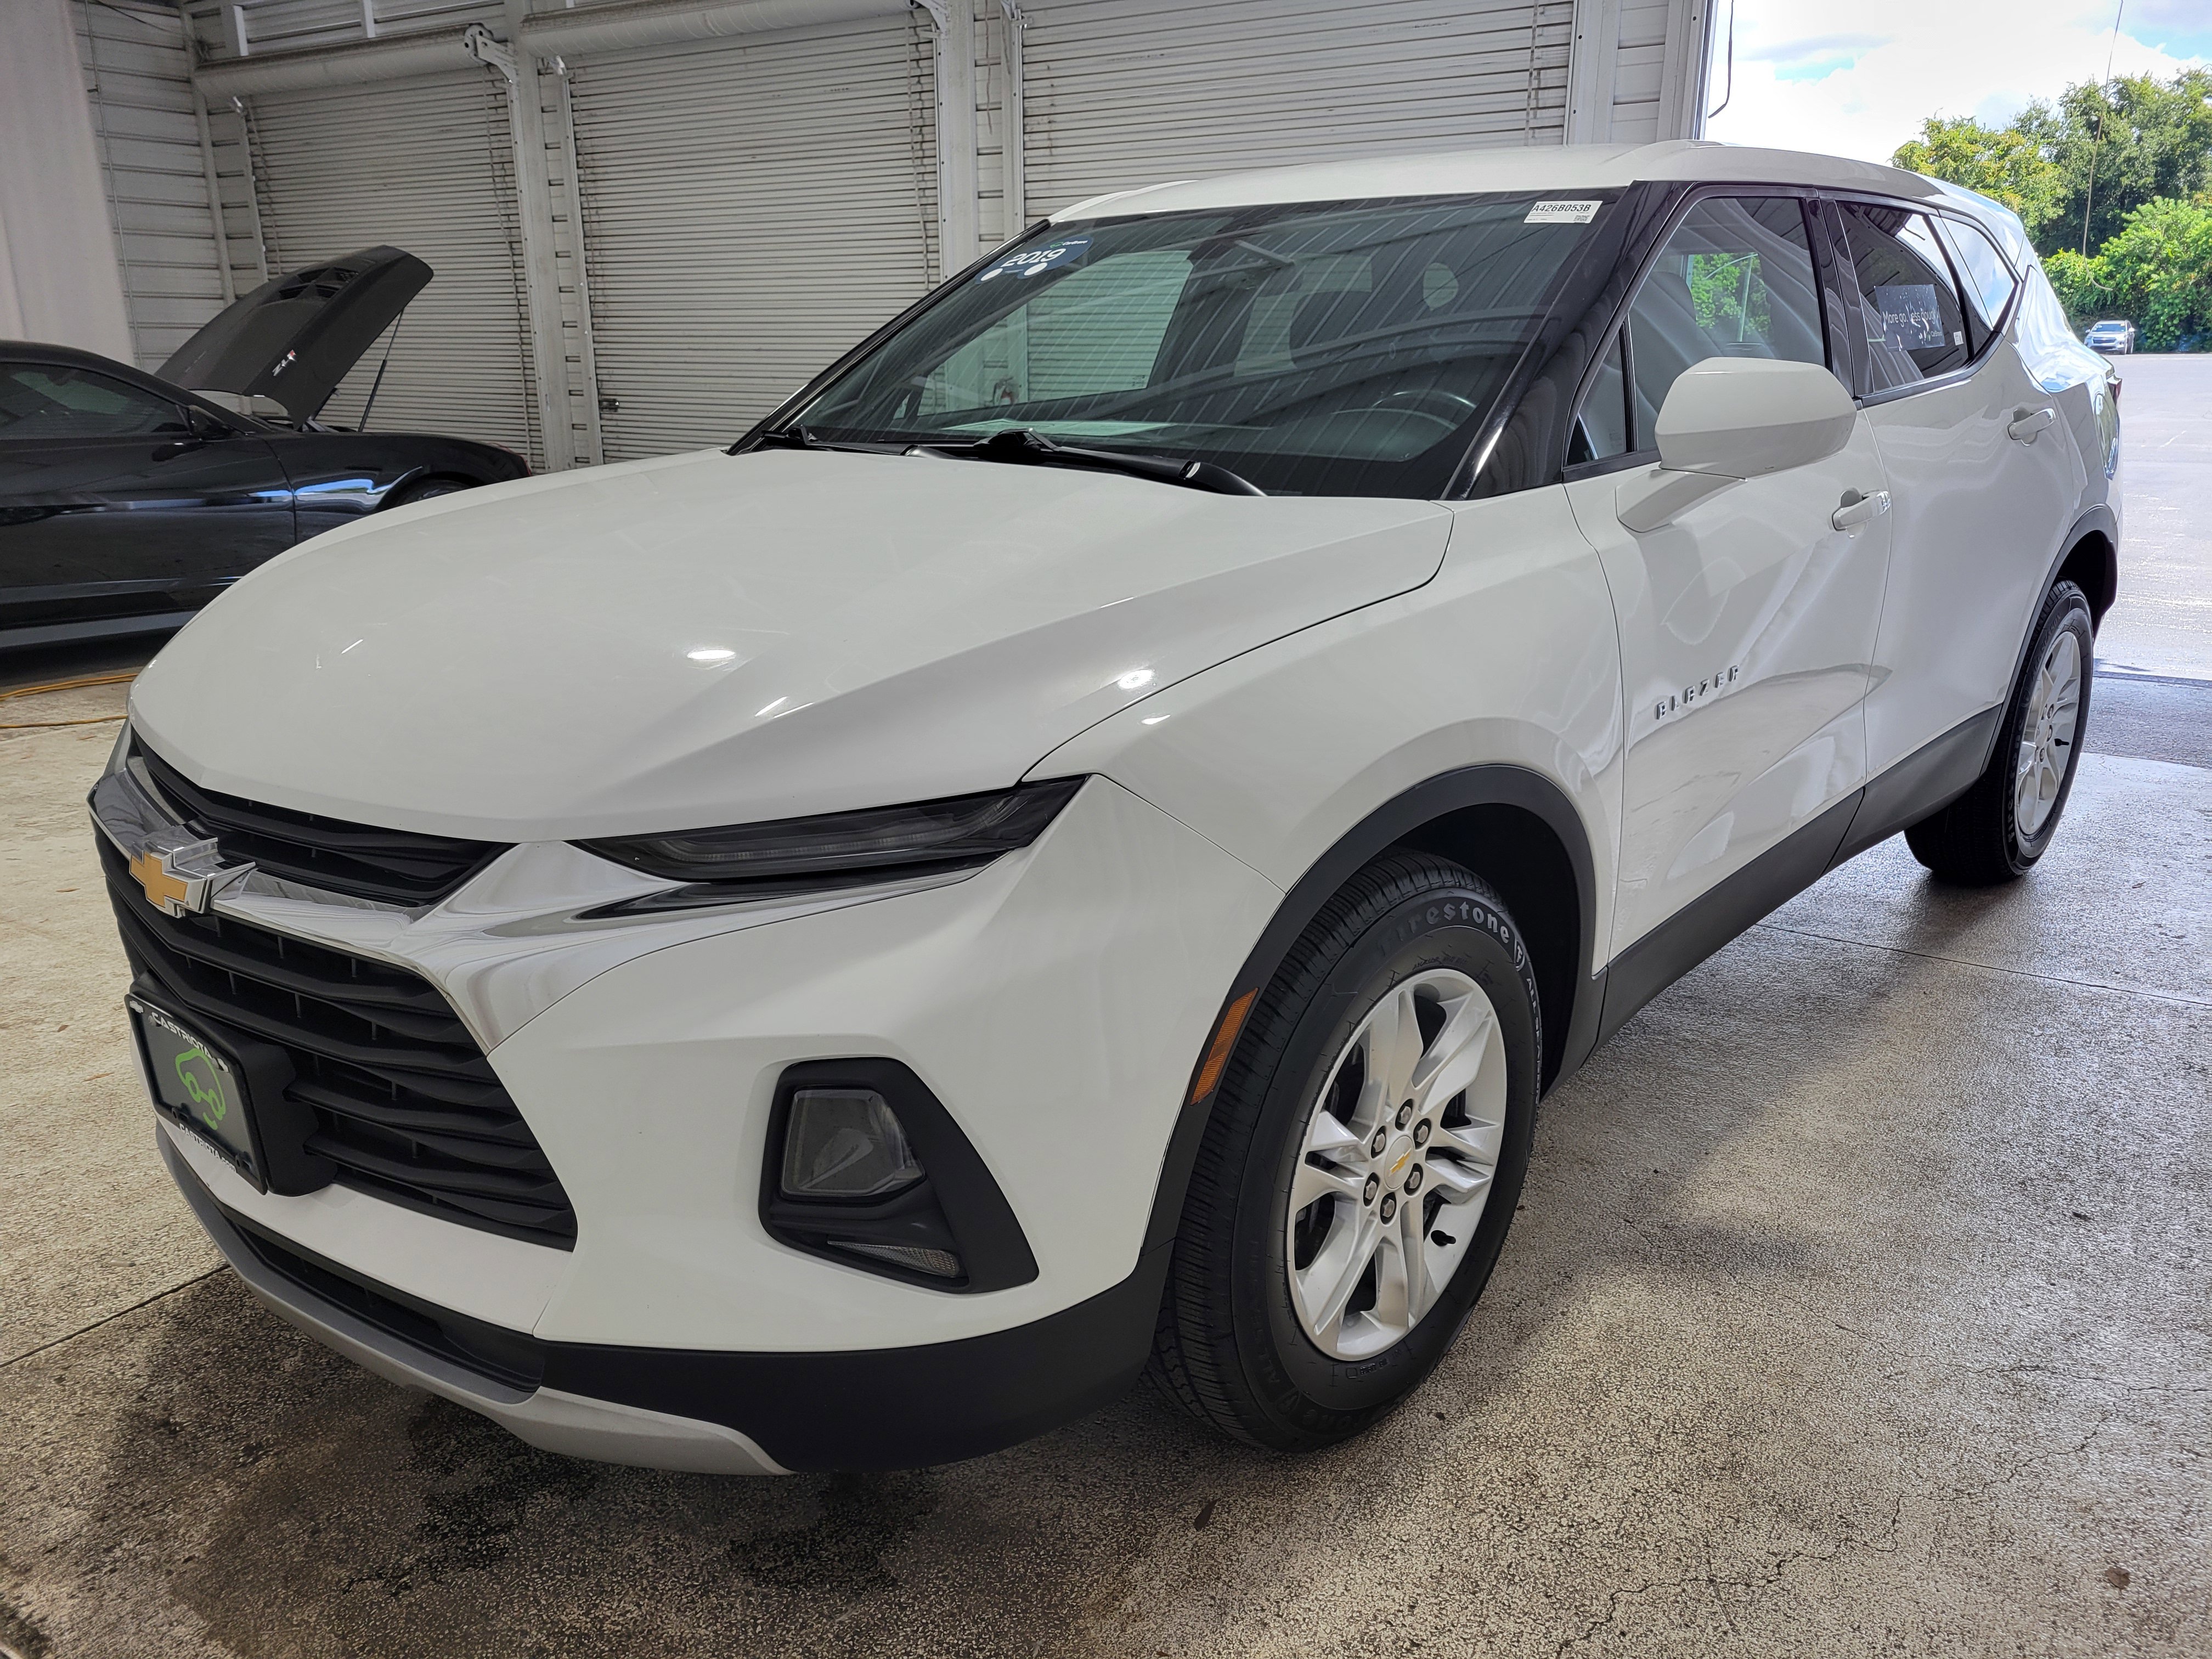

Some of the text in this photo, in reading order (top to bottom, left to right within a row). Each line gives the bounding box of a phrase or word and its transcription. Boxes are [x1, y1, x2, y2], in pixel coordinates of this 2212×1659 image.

[1531, 204, 1592, 212] A426B053B
[1000, 248, 1066, 267] 2019
[1882, 311, 1898, 324] More
[1899, 313, 1909, 328] go.
[1655, 665, 1739, 720] BLAZER
[1526, 978, 1537, 1014] ALL
[151, 1011, 212, 1060] CASTRIOTA
